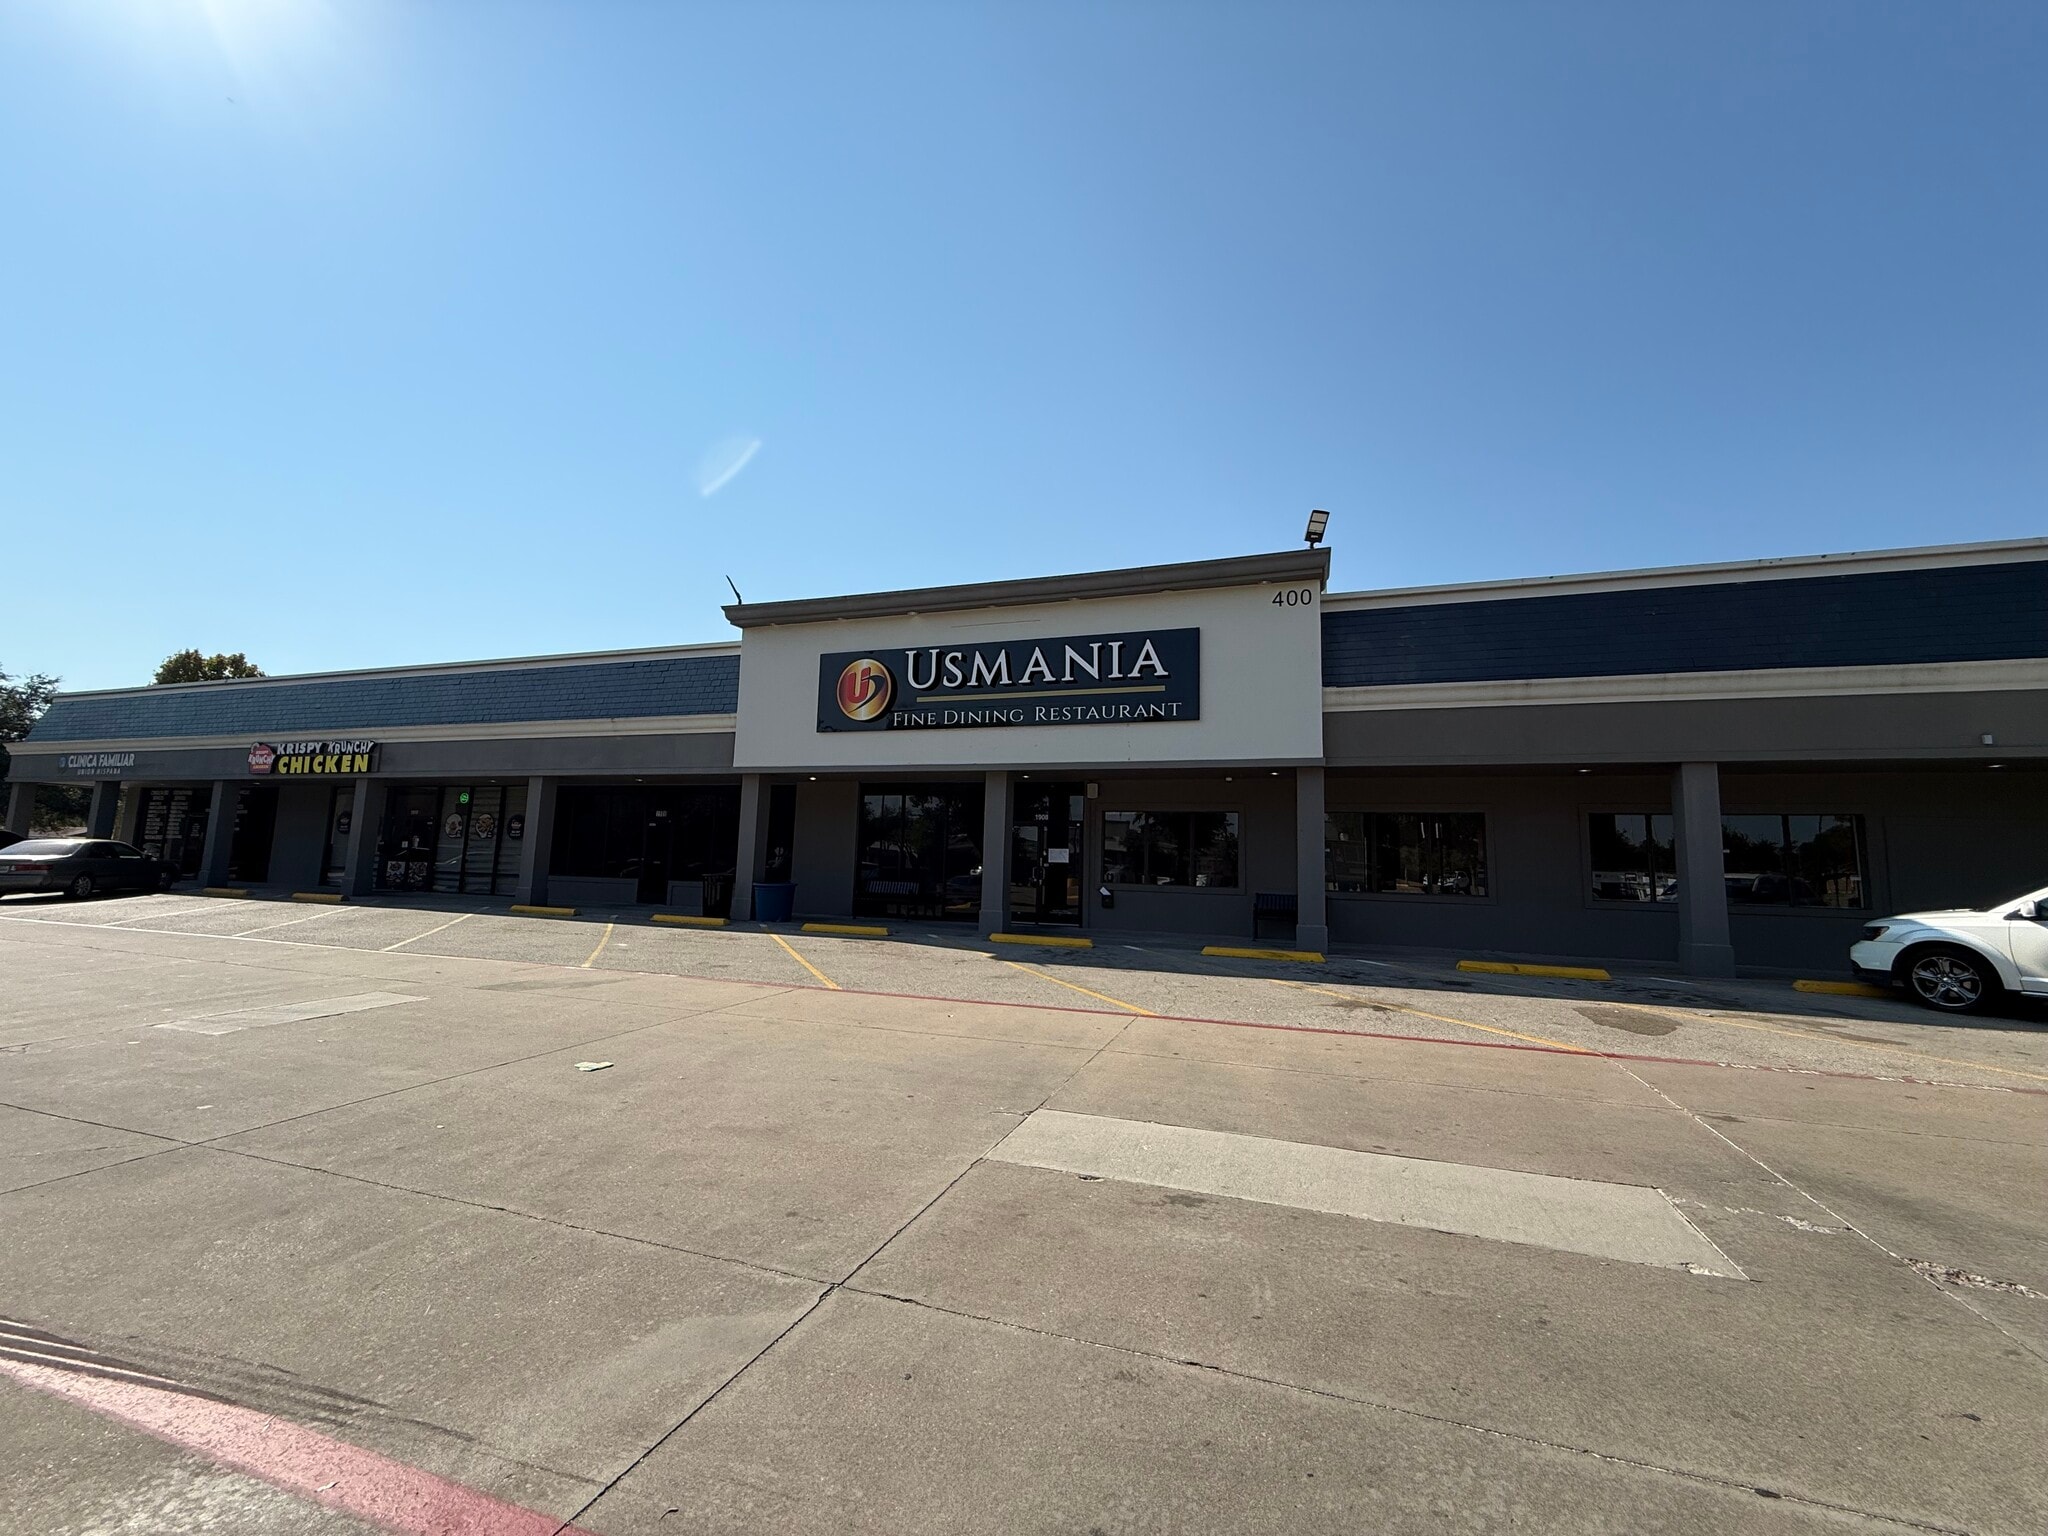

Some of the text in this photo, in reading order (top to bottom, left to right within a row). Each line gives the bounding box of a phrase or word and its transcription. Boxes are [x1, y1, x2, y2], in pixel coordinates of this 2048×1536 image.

[1271, 588, 1313, 608] 400
[905, 638, 1169, 690] USMANIA
[893, 702, 1182, 727] FINE DINING RESTAURANT
[277, 740, 374, 755] KRISPY KRUNCHY
[68, 753, 135, 768] CLINICA FAMILIAR
[278, 753, 370, 774] CHICKEN
